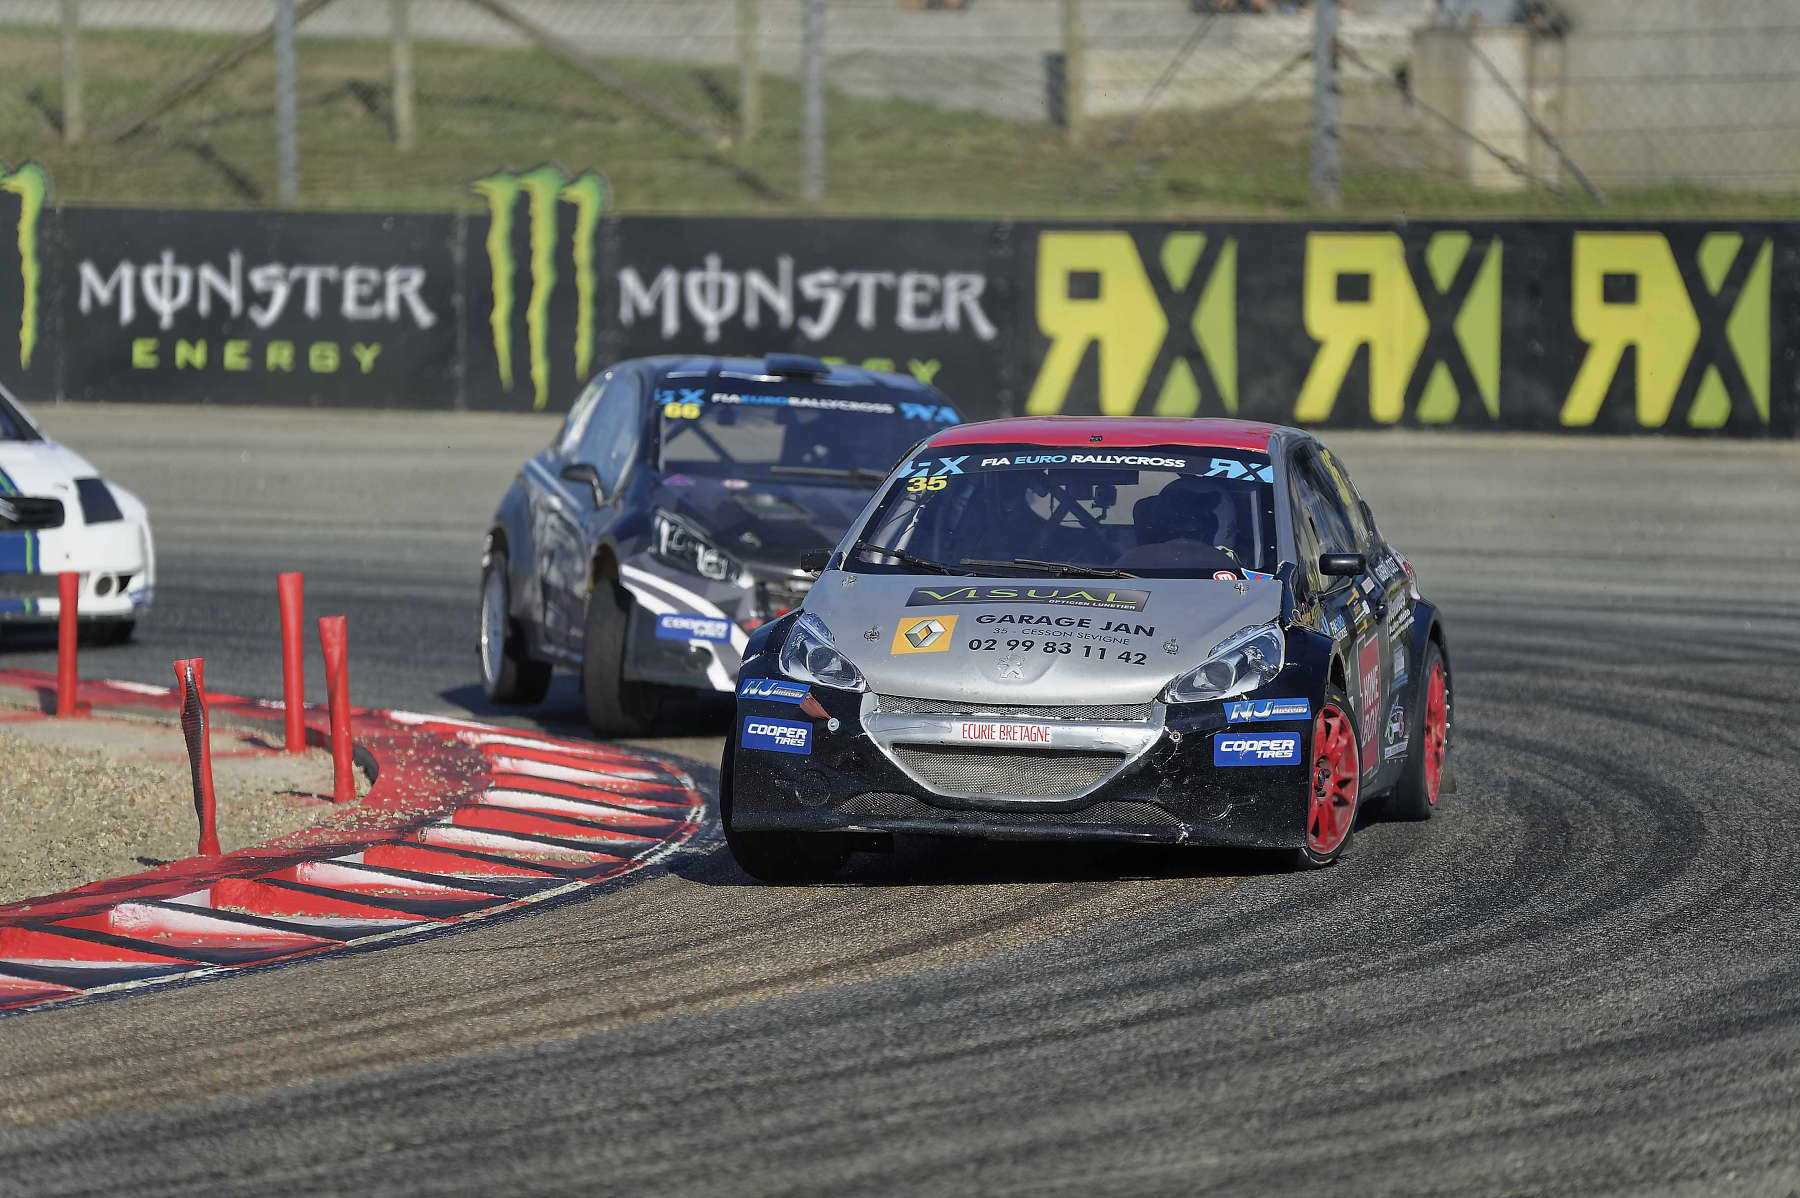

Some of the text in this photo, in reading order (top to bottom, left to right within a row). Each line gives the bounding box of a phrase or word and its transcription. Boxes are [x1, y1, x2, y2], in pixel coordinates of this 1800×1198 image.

[79, 250, 436, 330] MONSTER
[618, 252, 997, 343] MONSTER
[131, 337, 382, 373] ENERGY
[664, 402, 700, 419] 66
[980, 454, 1186, 468] FIA EURO RALLYCROSS
[906, 475, 948, 492] 35
[918, 587, 1137, 604] VISUAL
[1092, 602, 1136, 610] LUNETIER
[662, 616, 728, 632] COOPER
[975, 614, 1155, 637] GARAGE JAN
[1021, 628, 1073, 638] CESSON
[1076, 631, 1130, 646] SEVIGNE
[968, 638, 1147, 666] 02 99 83 11 42
[1231, 701, 1274, 721] NJ
[747, 723, 808, 739] COOPER
[962, 723, 1051, 742] ECURIE BRETAGNE
[774, 736, 806, 747] TIRES
[1220, 739, 1295, 752] COOPER
[1256, 750, 1294, 759] TIRES
